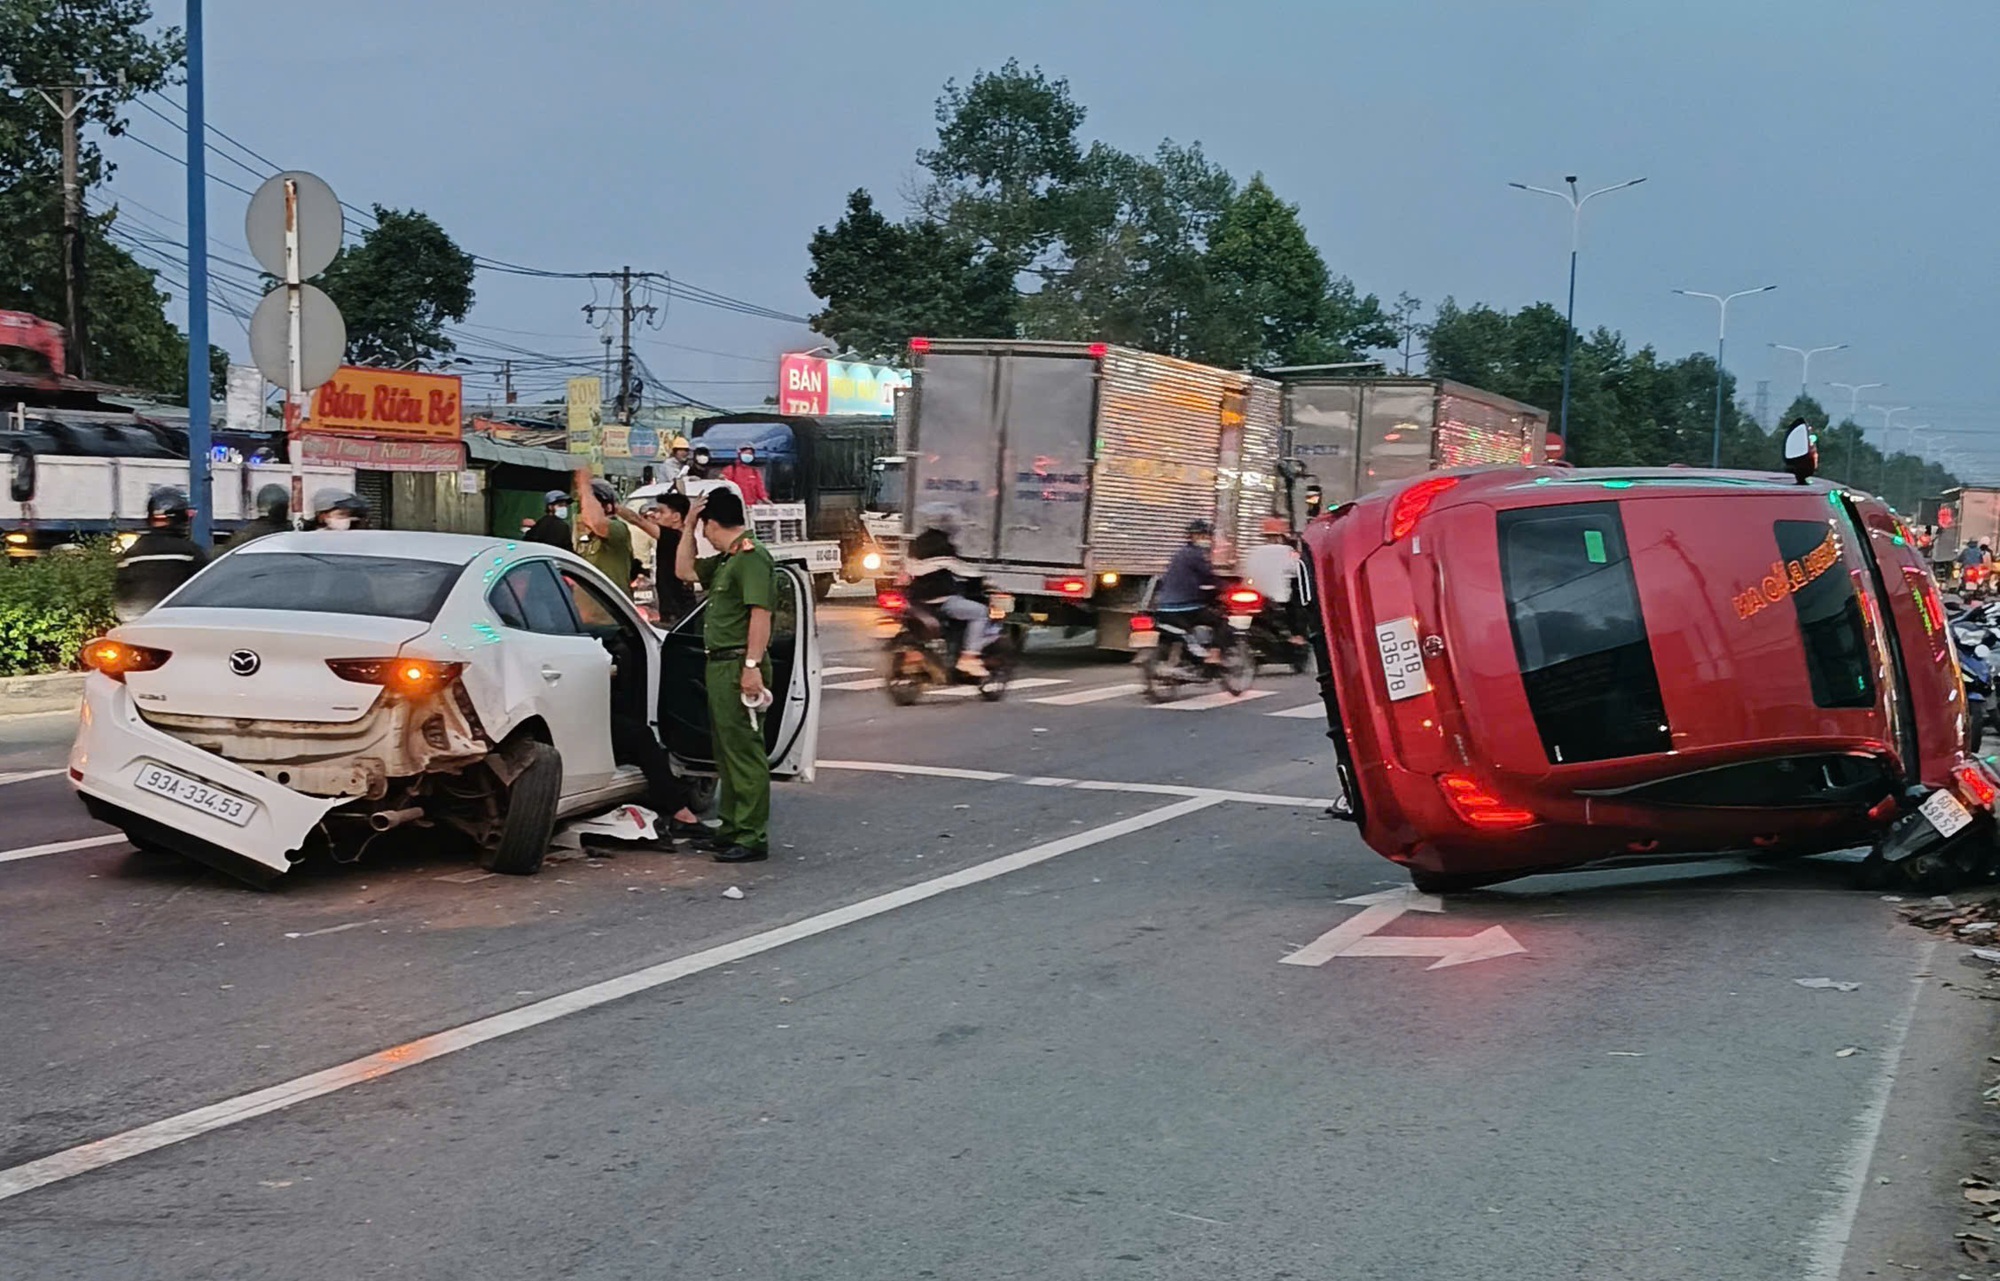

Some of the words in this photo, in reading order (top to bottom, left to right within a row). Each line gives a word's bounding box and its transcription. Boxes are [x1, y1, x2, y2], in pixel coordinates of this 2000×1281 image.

[789, 365, 822, 393] BÁN
[318, 380, 367, 419] Bún
[372, 385, 423, 423] Riêu
[428, 389, 456, 426] Bé
[1380, 631, 1406, 691] 036.78
[1400, 640, 1421, 673] 61B
[147, 771, 243, 817] 93A-334.53
